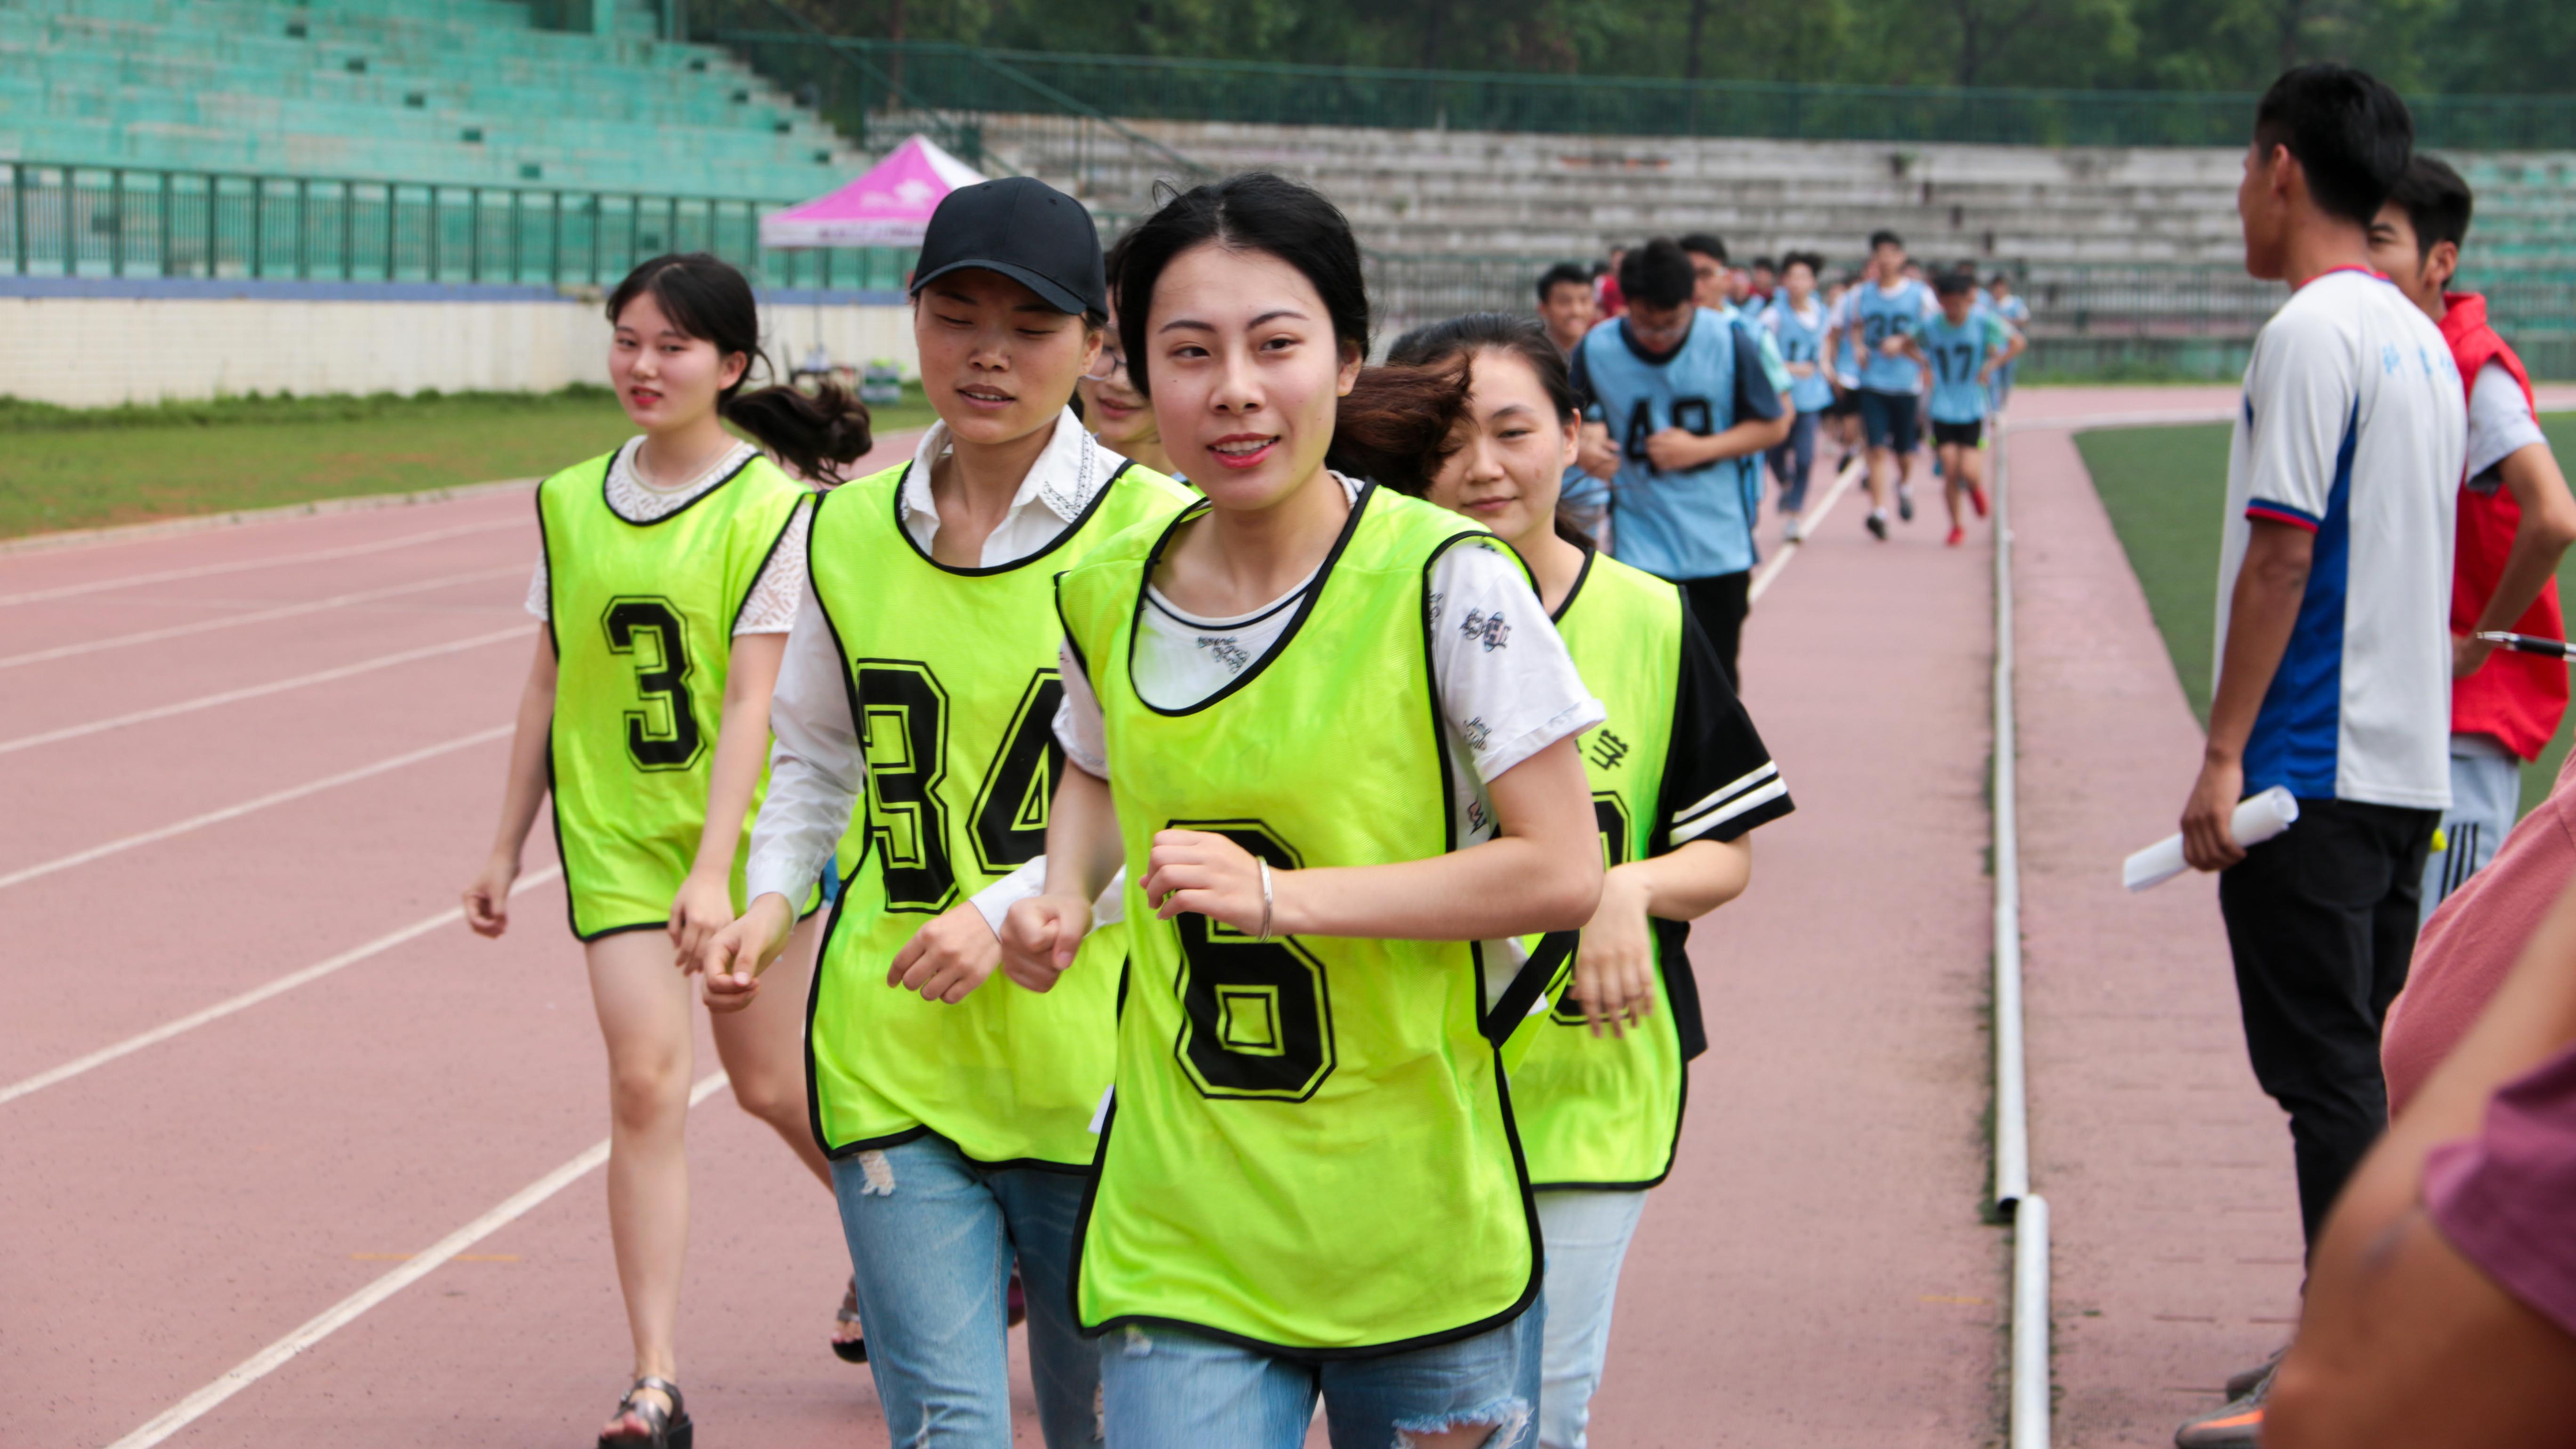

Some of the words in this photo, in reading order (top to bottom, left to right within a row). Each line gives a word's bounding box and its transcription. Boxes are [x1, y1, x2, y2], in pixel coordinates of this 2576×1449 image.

[1935, 344, 1973, 383] 17
[601, 595, 706, 772] 3
[857, 659, 1065, 913] 34
[1166, 819, 1337, 1103] 6
